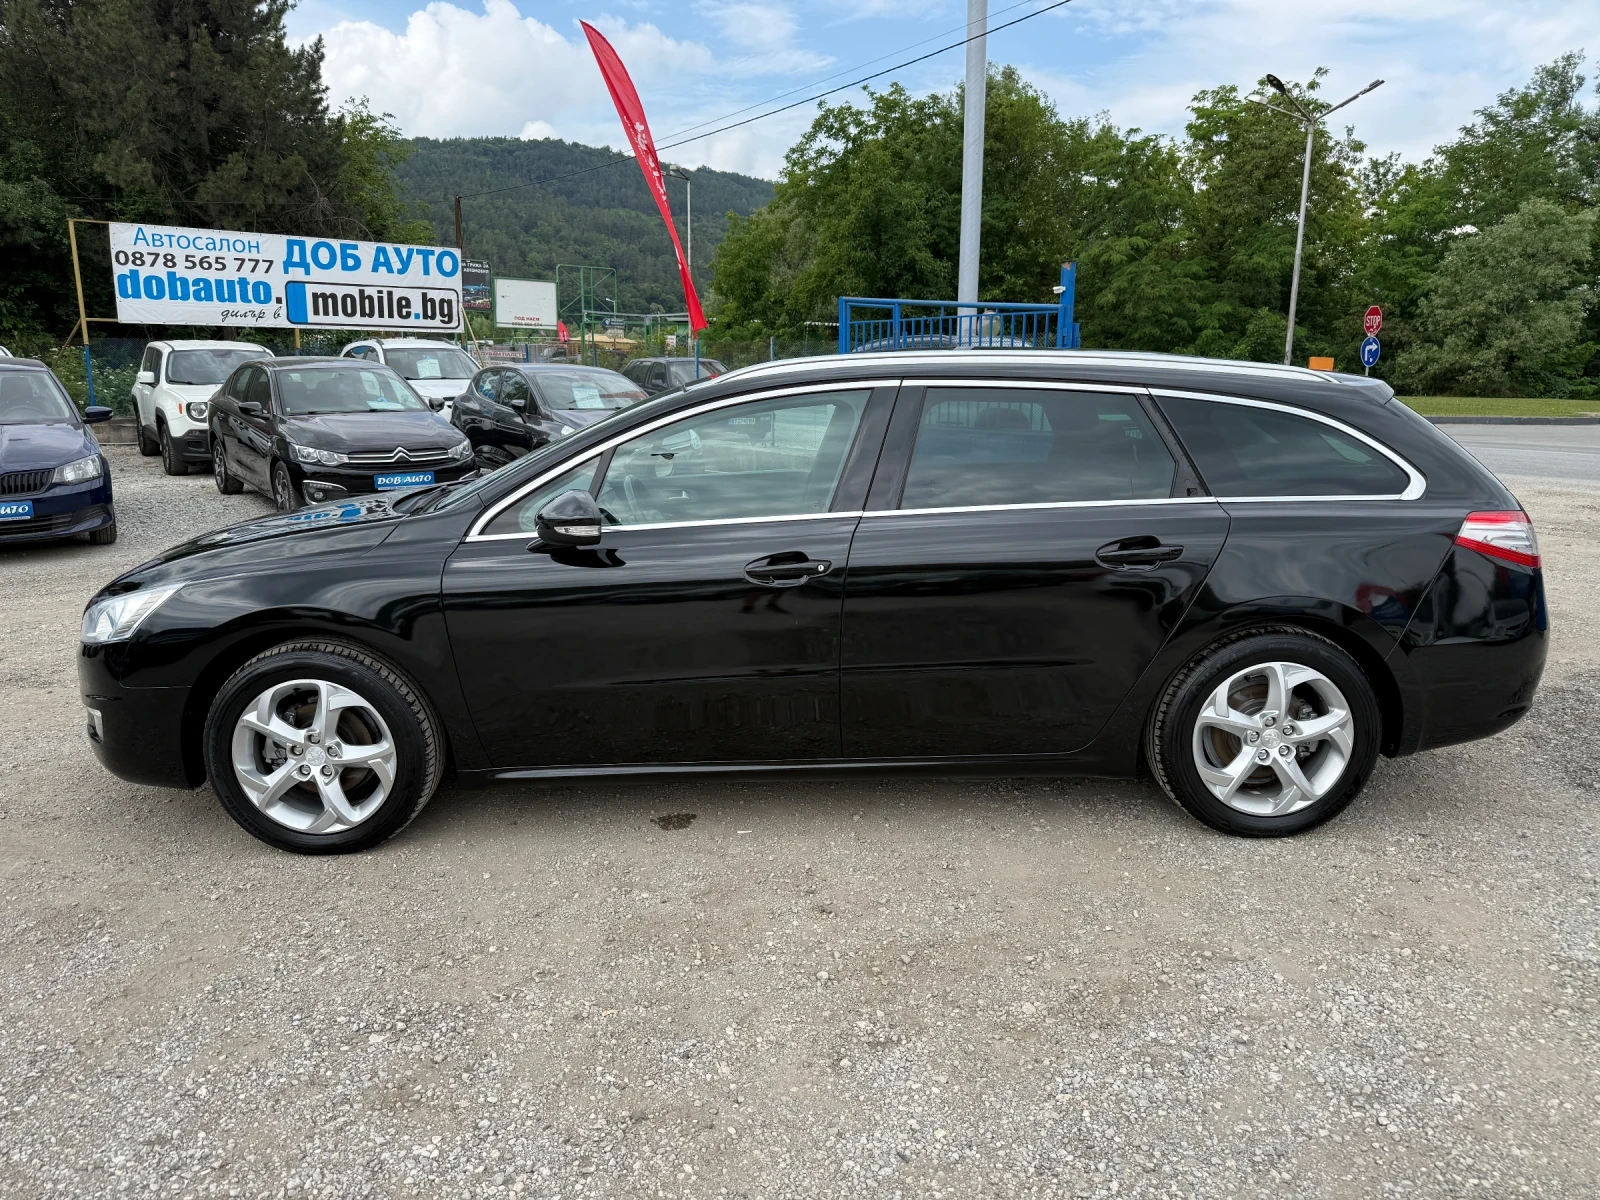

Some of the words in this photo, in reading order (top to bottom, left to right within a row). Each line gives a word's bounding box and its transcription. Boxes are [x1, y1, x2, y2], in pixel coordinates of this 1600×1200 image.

[133, 227, 261, 254] Автосалон
[114, 250, 177, 268] 0878
[184, 254, 227, 271] 565
[233, 257, 274, 274] 777
[282, 239, 362, 276] ДОБ
[371, 245, 459, 278] АУТО
[220, 309, 267, 322] дилър
[273, 306, 282, 319] в
[311, 288, 454, 325] mobile.bg
[1366, 315, 1380, 327] STOP
[377, 476, 402, 485] DOB
[403, 474, 432, 483] AUTO
